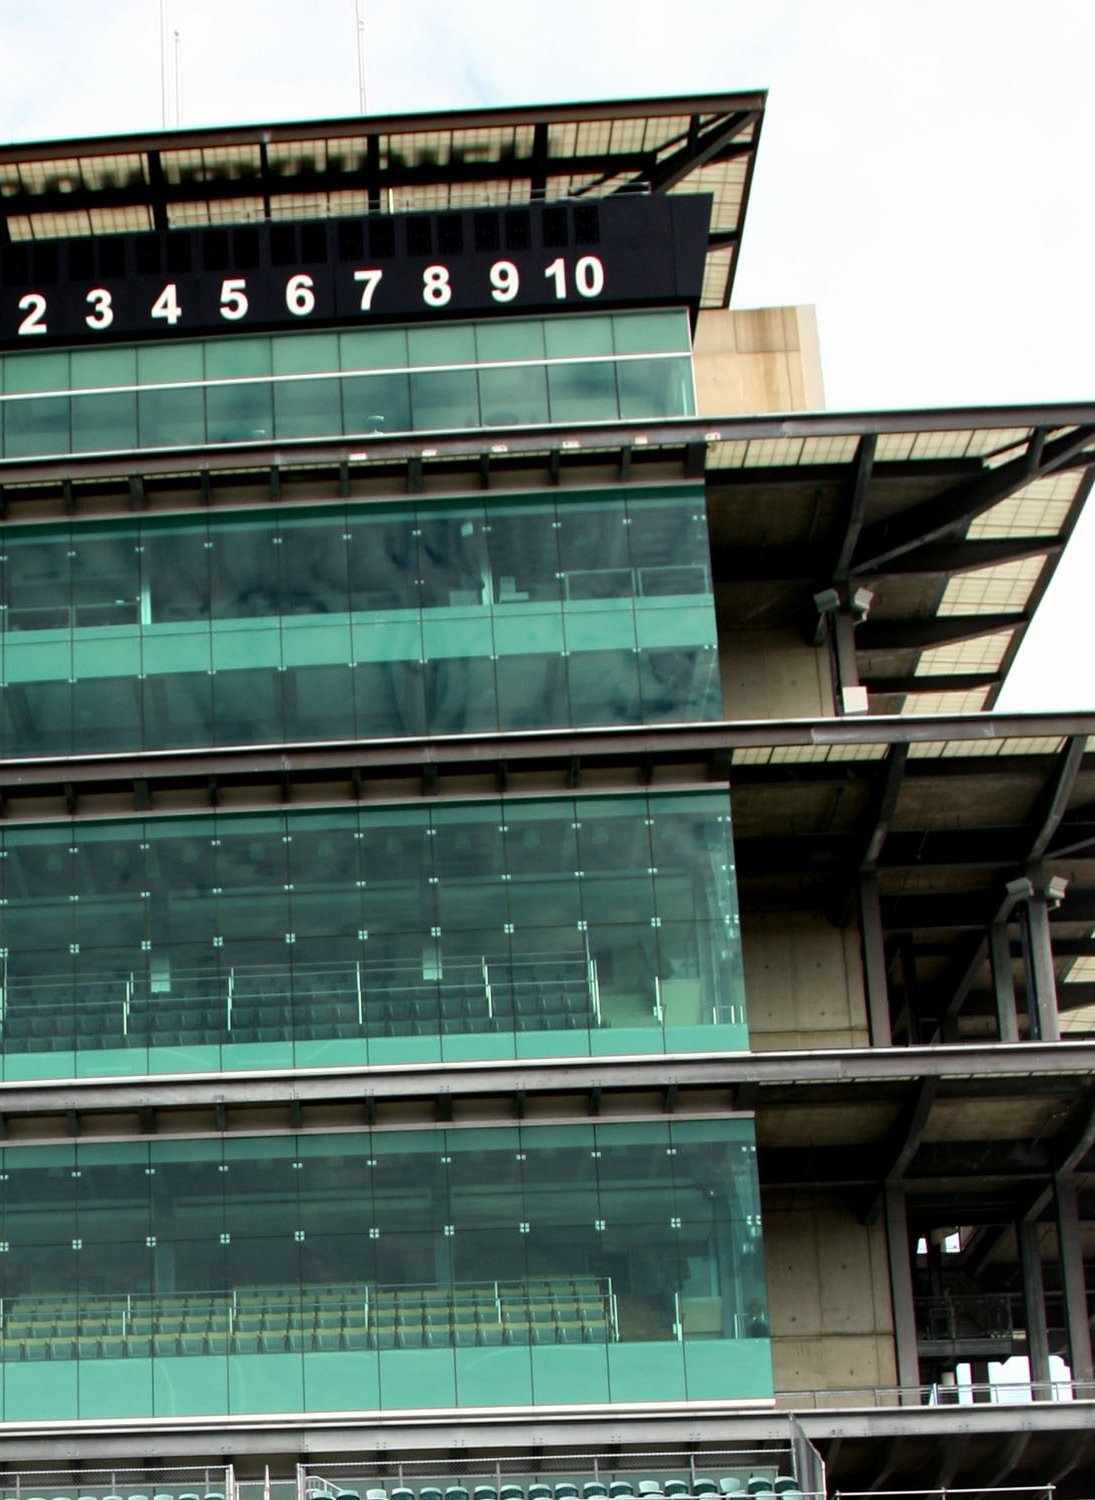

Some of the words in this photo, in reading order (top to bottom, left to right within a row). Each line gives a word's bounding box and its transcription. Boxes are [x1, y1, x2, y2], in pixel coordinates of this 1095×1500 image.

[18, 293, 47, 335] 2
[85, 288, 114, 330] 3
[151, 284, 182, 325] 4
[219, 278, 249, 320] 5
[285, 274, 315, 316] 6
[353, 269, 383, 311] 7
[422, 265, 452, 307] 8
[489, 260, 520, 303] 9
[544, 256, 605, 299] 10
